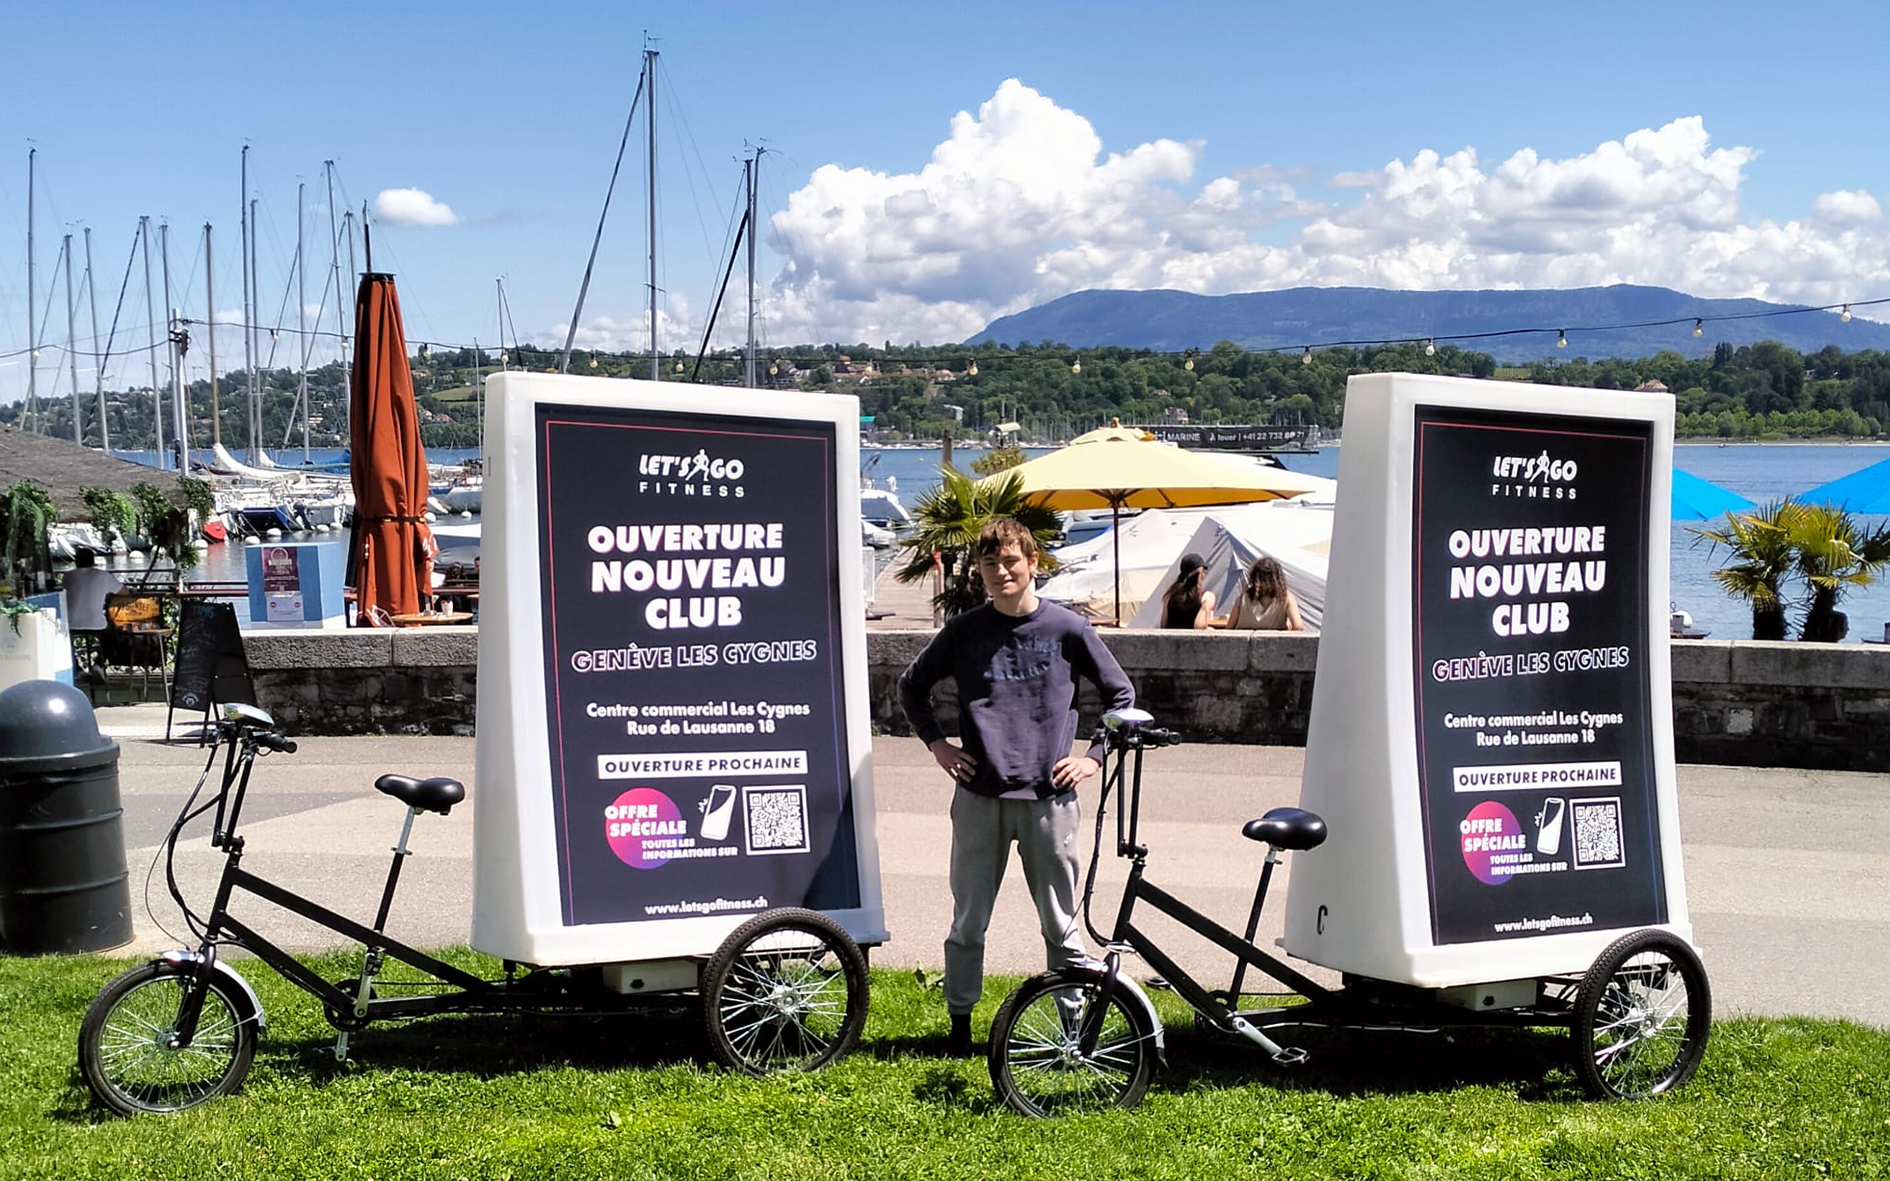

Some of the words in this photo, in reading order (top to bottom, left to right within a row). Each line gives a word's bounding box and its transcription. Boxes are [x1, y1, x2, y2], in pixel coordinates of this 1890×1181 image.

[1167, 433, 1200, 442] MARINE
[1256, 432, 1267, 440] 22
[1269, 432, 1282, 440] 732
[639, 454, 691, 477] LET'S
[710, 459, 744, 480] GO
[1493, 456, 1536, 479] LET'S
[1550, 460, 1578, 481] GO
[640, 482, 744, 498] FITNESS
[1492, 485, 1576, 499] FITNESS
[587, 523, 783, 553] OUVERTURE
[1449, 526, 1605, 558] OUVERTURE
[591, 556, 786, 593] NOUVEAU
[1450, 561, 1606, 599] NOUVEAU
[645, 596, 742, 630] CLUB
[1492, 602, 1570, 636] CLUB
[571, 643, 671, 672] GENÈVE
[677, 644, 718, 666] LES
[723, 640, 817, 664] CYGNES
[1432, 651, 1513, 682] GENÈVE
[1517, 650, 1550, 675] LES
[1554, 647, 1630, 672] CYGNES
[586, 702, 638, 717] Centre
[642, 701, 727, 717] commercial
[730, 702, 755, 716] Les
[757, 701, 810, 719] Cygnes
[627, 721, 657, 736] Rue
[660, 720, 680, 735] de
[683, 721, 754, 735] Lausanne
[758, 719, 775, 733] 18
[1444, 713, 1485, 728] Centre
[1488, 711, 1557, 727] commercial
[1560, 712, 1579, 725] Les
[1580, 711, 1624, 728] Cygnes
[1476, 732, 1501, 747] Rue
[1504, 730, 1519, 746] de
[1522, 731, 1578, 746] Lausanne
[1582, 729, 1596, 743] 18
[605, 760, 703, 774] OUVERTURE
[709, 757, 801, 771] PROCHAINE
[1459, 771, 1538, 786] OUVERTURE
[1542, 768, 1616, 783] PROCHAINE
[604, 804, 657, 819] OFFRE
[609, 818, 687, 837] SPÉCIALE
[1460, 819, 1502, 834] OFFRE
[642, 840, 677, 849] TOUTES
[678, 838, 695, 848] LES
[1464, 834, 1526, 852] SPÉCIALE
[643, 848, 717, 860] INFORMATIONS
[718, 847, 738, 856] SUR
[1490, 854, 1518, 864] TOUTES
[1520, 853, 1533, 862] LES
[1491, 863, 1550, 875] INFORMATIONS
[1551, 862, 1568, 871] SUR
[645, 897, 768, 915] www.letsgofitness.ch
[1494, 913, 1593, 932] www.letsgofitness.ch
